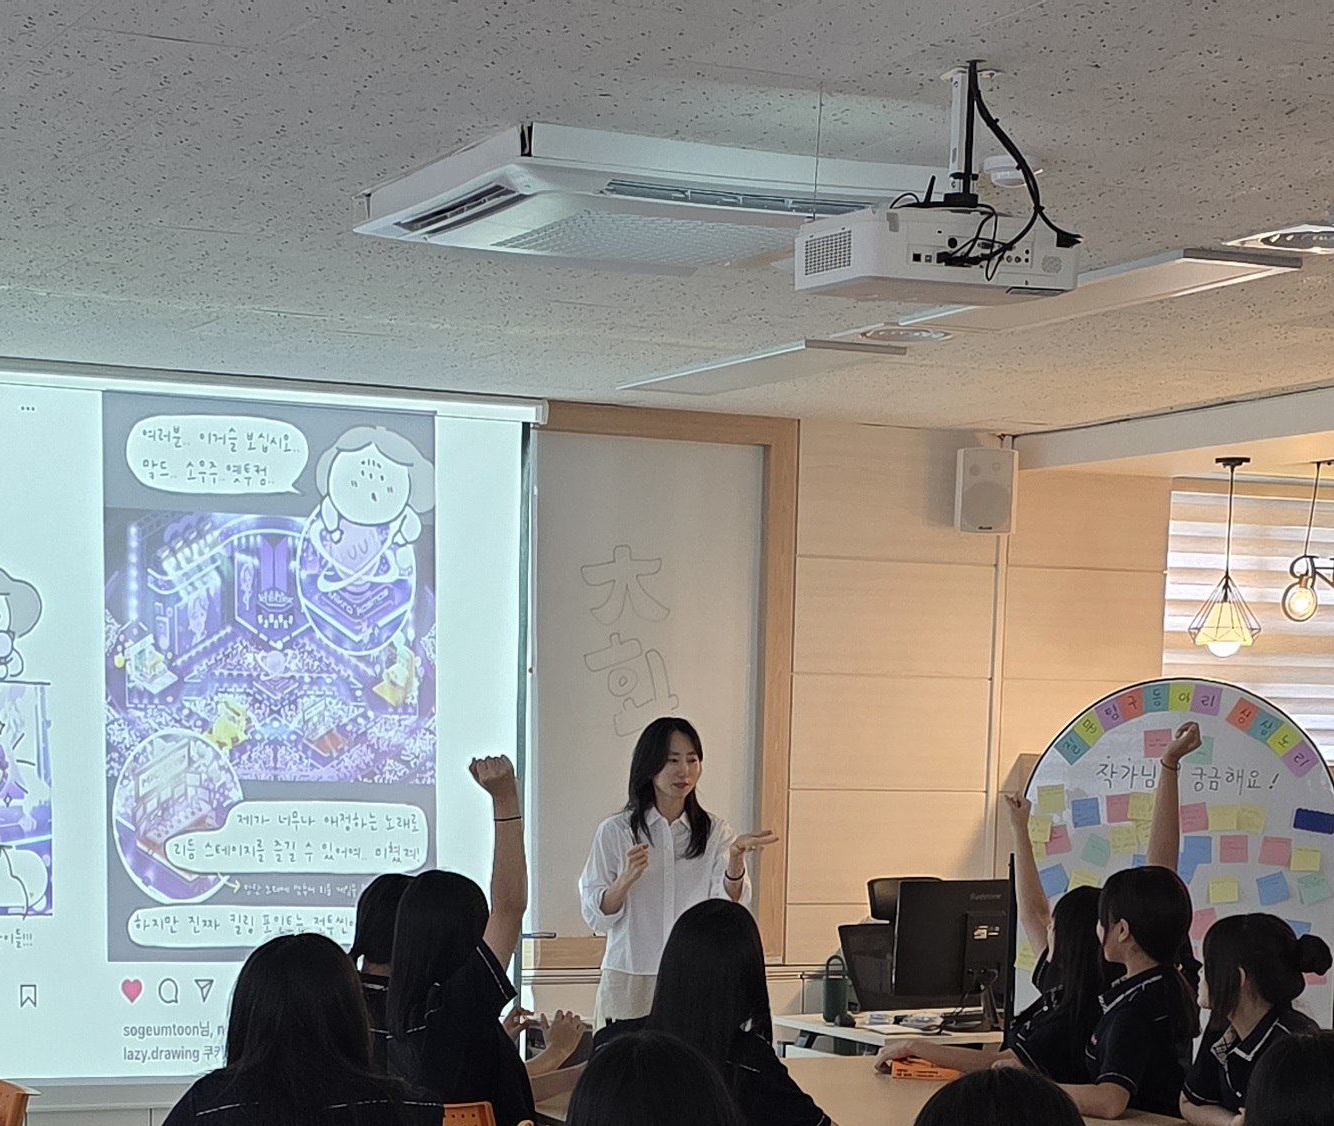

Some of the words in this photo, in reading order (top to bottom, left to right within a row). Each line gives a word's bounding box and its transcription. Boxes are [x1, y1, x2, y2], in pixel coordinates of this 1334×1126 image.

[1096, 763, 1157, 789] 작가님
[237, 814, 270, 826] 제가
[278, 811, 315, 831] 너무나
[324, 812, 378, 832] 애정하는
[386, 813, 419, 833] 노래로
[174, 839, 196, 860] 리듬
[204, 839, 264, 863] 스테이지를
[273, 840, 296, 863] 즐길
[304, 842, 313, 863] 수
[134, 914, 179, 934] 하지만
[188, 916, 220, 934] 진짜
[229, 913, 254, 935] 킬링
[123, 1046, 200, 1063] lazy.drawing
